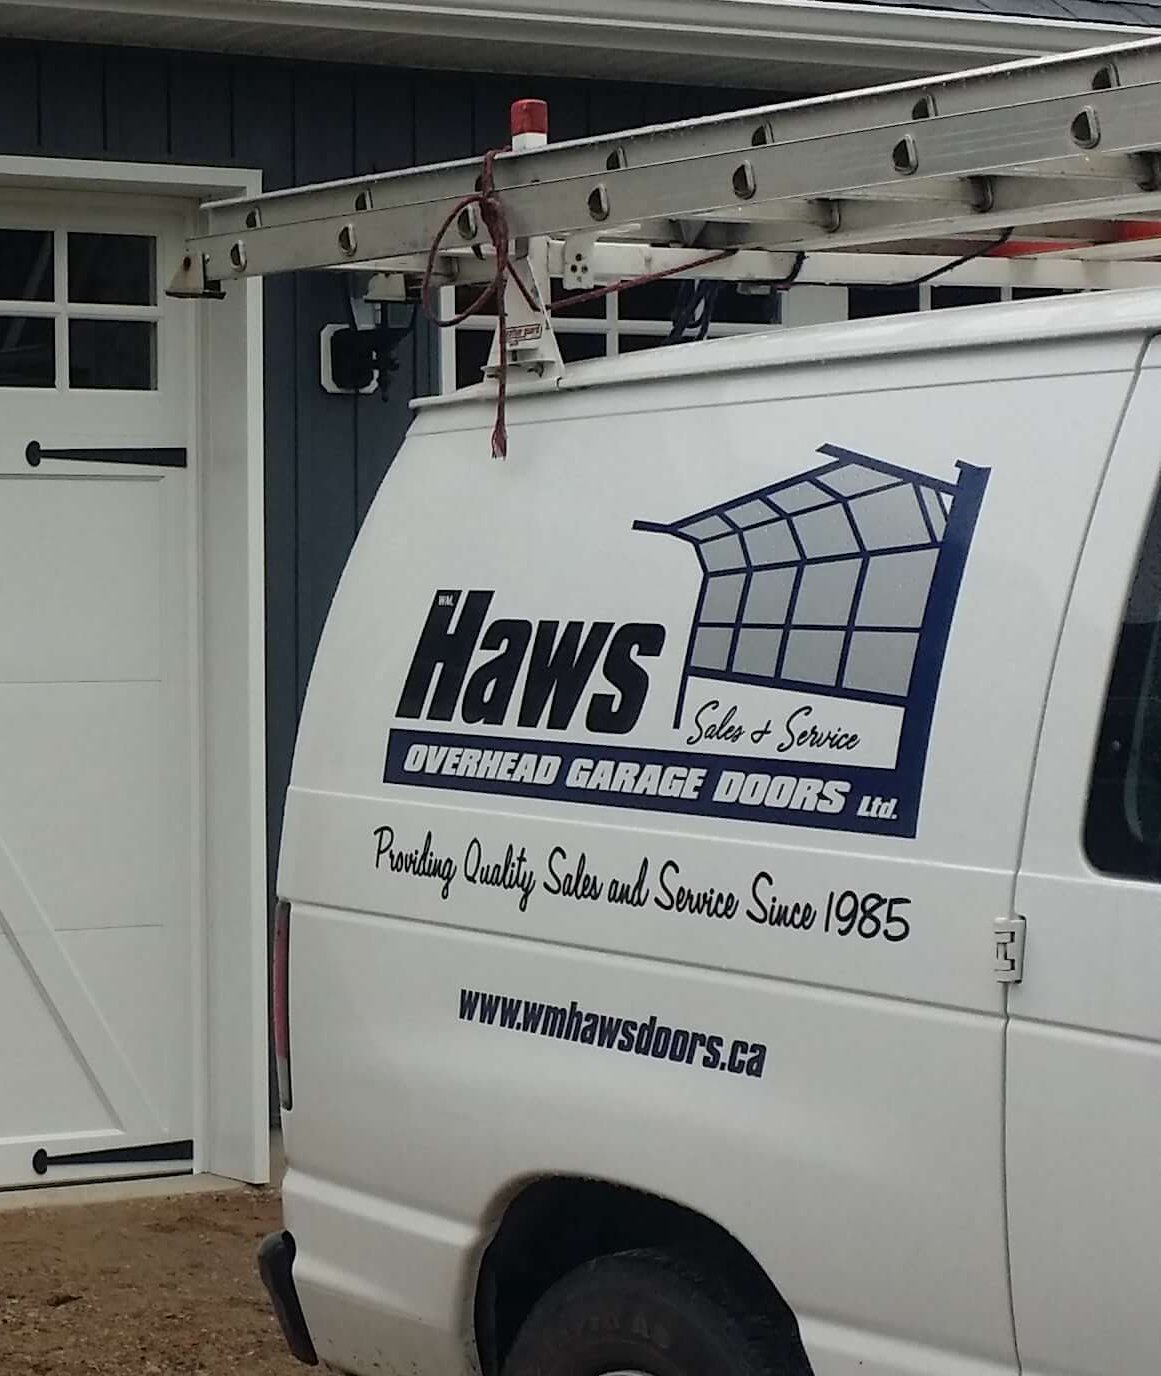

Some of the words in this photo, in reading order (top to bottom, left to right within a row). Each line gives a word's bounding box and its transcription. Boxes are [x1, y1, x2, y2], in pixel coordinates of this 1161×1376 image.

[395, 590, 666, 734] Haws
[687, 700, 744, 745] Sales
[776, 706, 860, 752] Service
[404, 744, 561, 785] OVERHEAD
[566, 758, 707, 799] GARAGE
[712, 771, 851, 814] DOORS
[857, 795, 898, 819] Ltd.
[374, 826, 457, 899] Providing
[464, 838, 536, 912] Quality
[543, 846, 603, 901] Sales
[608, 857, 650, 907] and
[654, 860, 739, 919] Service
[746, 871, 816, 930] Since
[825, 891, 911, 942] 1985
[459, 989, 768, 1078] www.wmhawsdoors.ca
